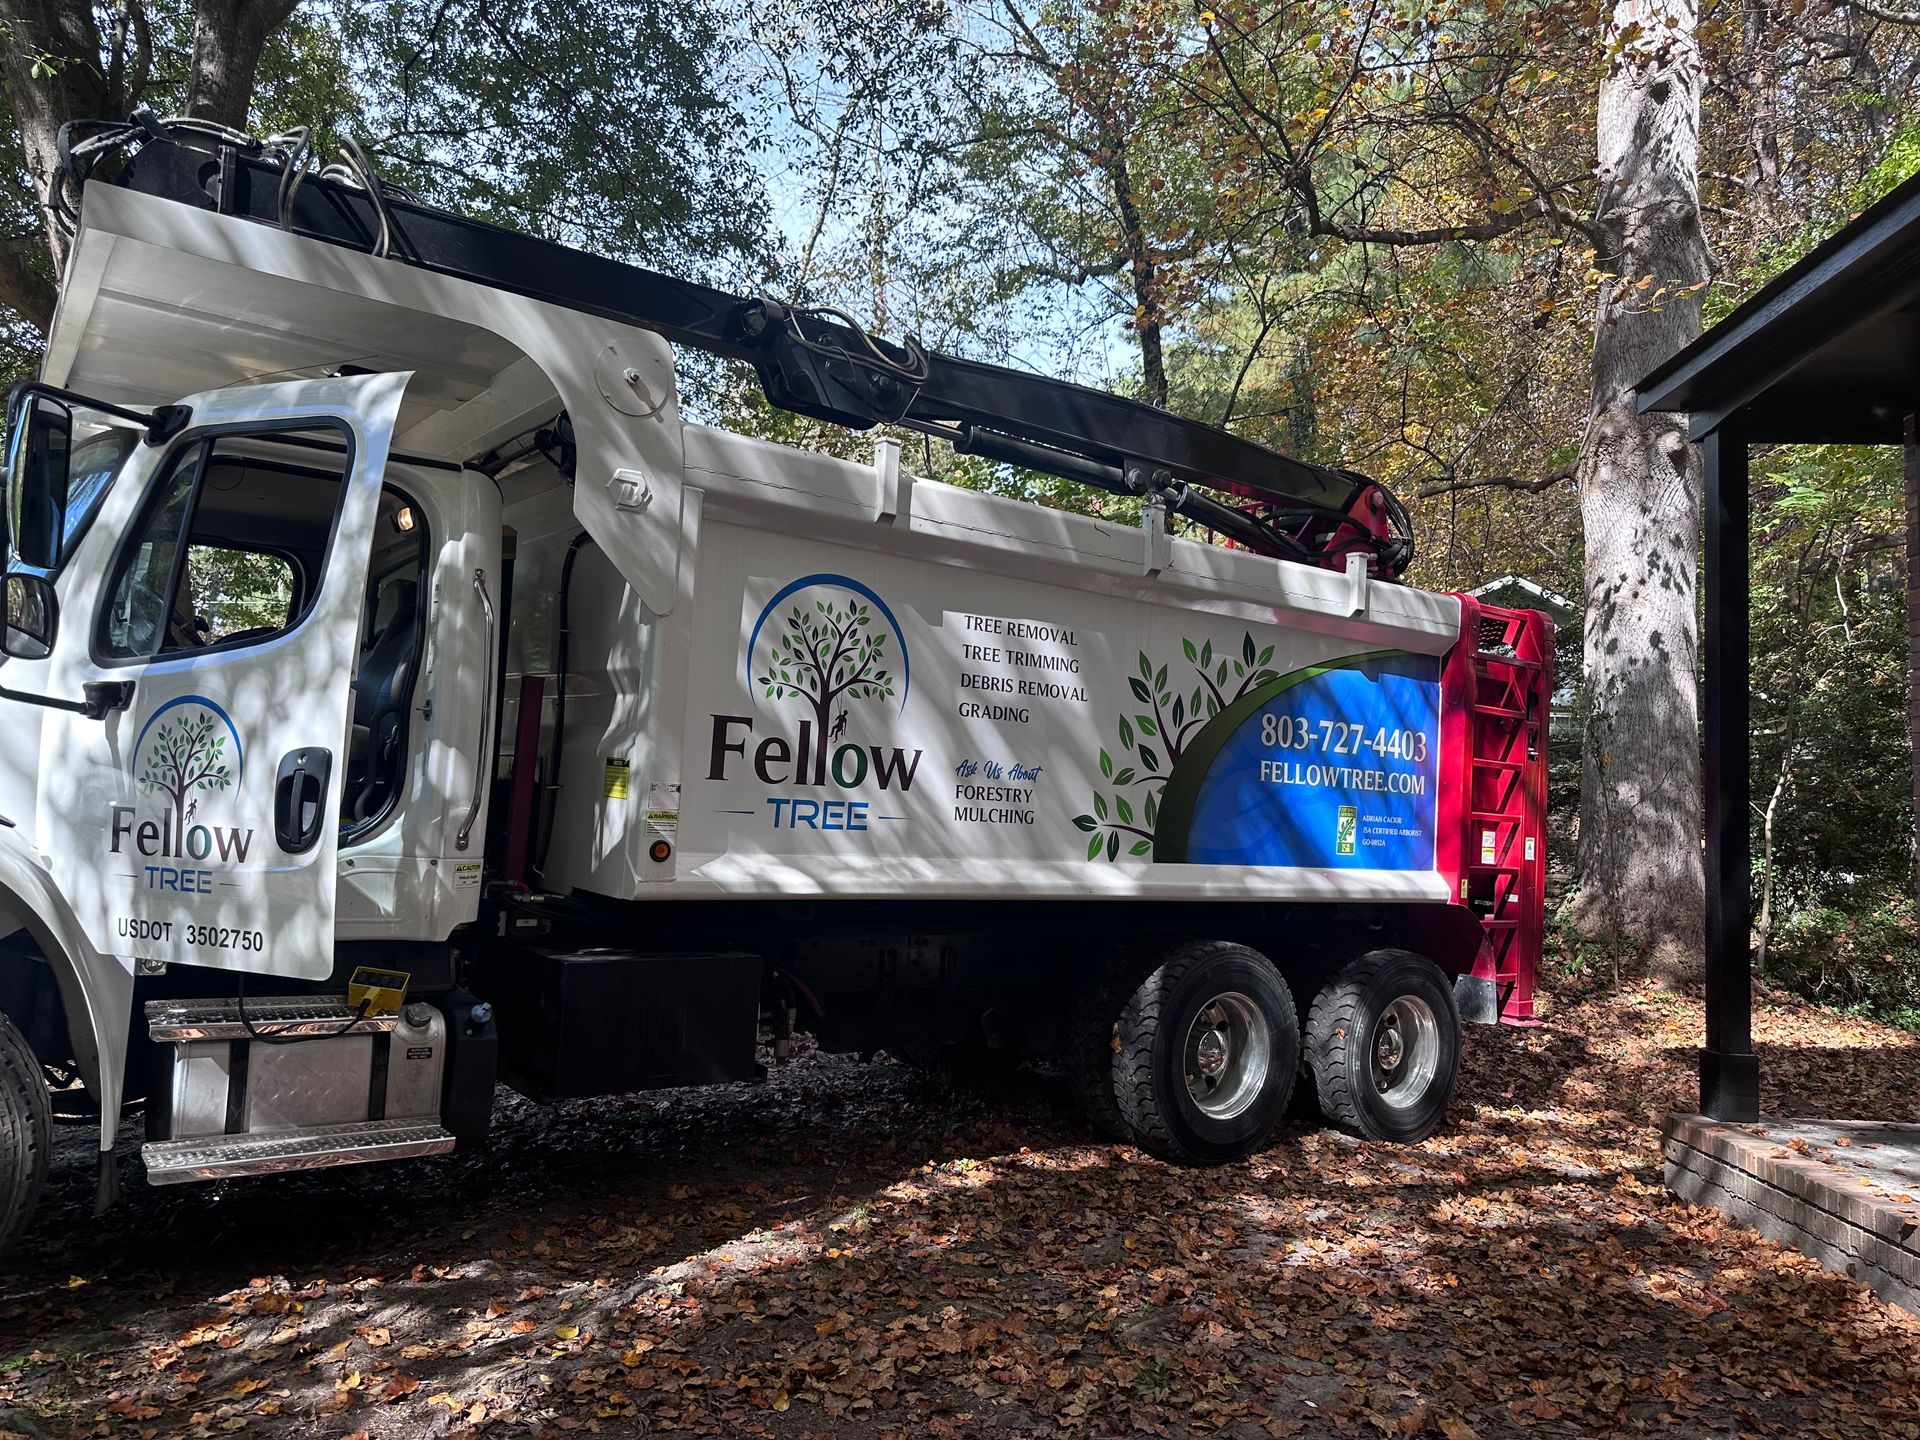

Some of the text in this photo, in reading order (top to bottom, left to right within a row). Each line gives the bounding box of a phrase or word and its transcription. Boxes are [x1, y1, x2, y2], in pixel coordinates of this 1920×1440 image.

[964, 614, 1078, 646] TREE REMOVAL
[962, 643, 1079, 673] TREE TRIMMING
[960, 673, 1088, 702] DEBRIS REMOVAL
[958, 702, 1029, 723] GRADING
[705, 713, 924, 791] Fellow
[1260, 713, 1427, 762] 803-727-4403
[955, 759, 1043, 783] Ask Us About
[1260, 760, 1425, 795] FELLOWTREE.COM
[955, 784, 1033, 803] FORESTRY
[767, 798, 869, 831] TREE
[954, 806, 1034, 825] MULCHING
[1362, 815, 1382, 823] ADRIAN
[108, 806, 254, 863] Fellow
[1372, 827, 1398, 836] CERTIFIED
[1399, 829, 1422, 837] ARBORIST
[145, 866, 212, 894] TREE
[118, 917, 263, 951] USDOT 3502750
